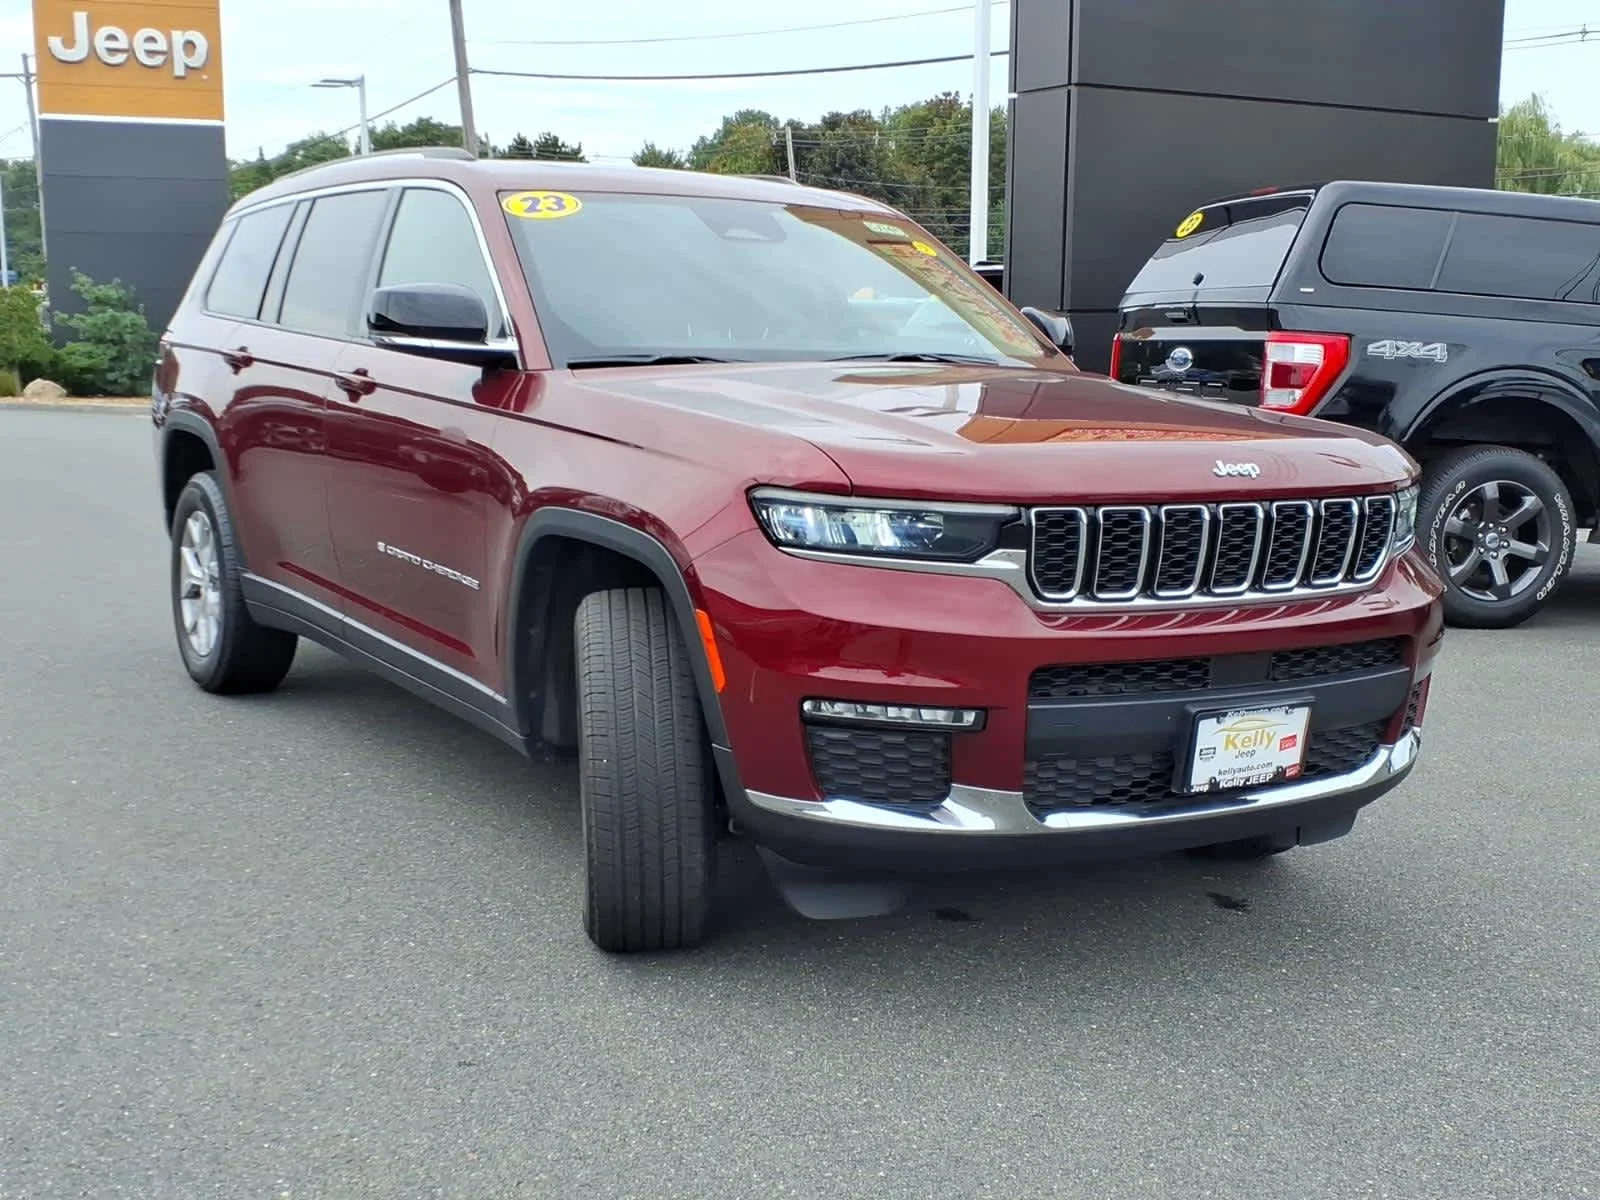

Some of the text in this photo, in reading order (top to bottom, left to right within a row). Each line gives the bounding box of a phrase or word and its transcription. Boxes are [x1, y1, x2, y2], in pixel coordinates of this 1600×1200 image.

[47, 11, 209, 79] Jeep
[519, 194, 567, 213] 23
[1212, 459, 1261, 479] Jeep
[1223, 728, 1277, 752] Kelly
[1234, 748, 1256, 760] Jeep
[1217, 761, 1273, 776] kellyauto.com
